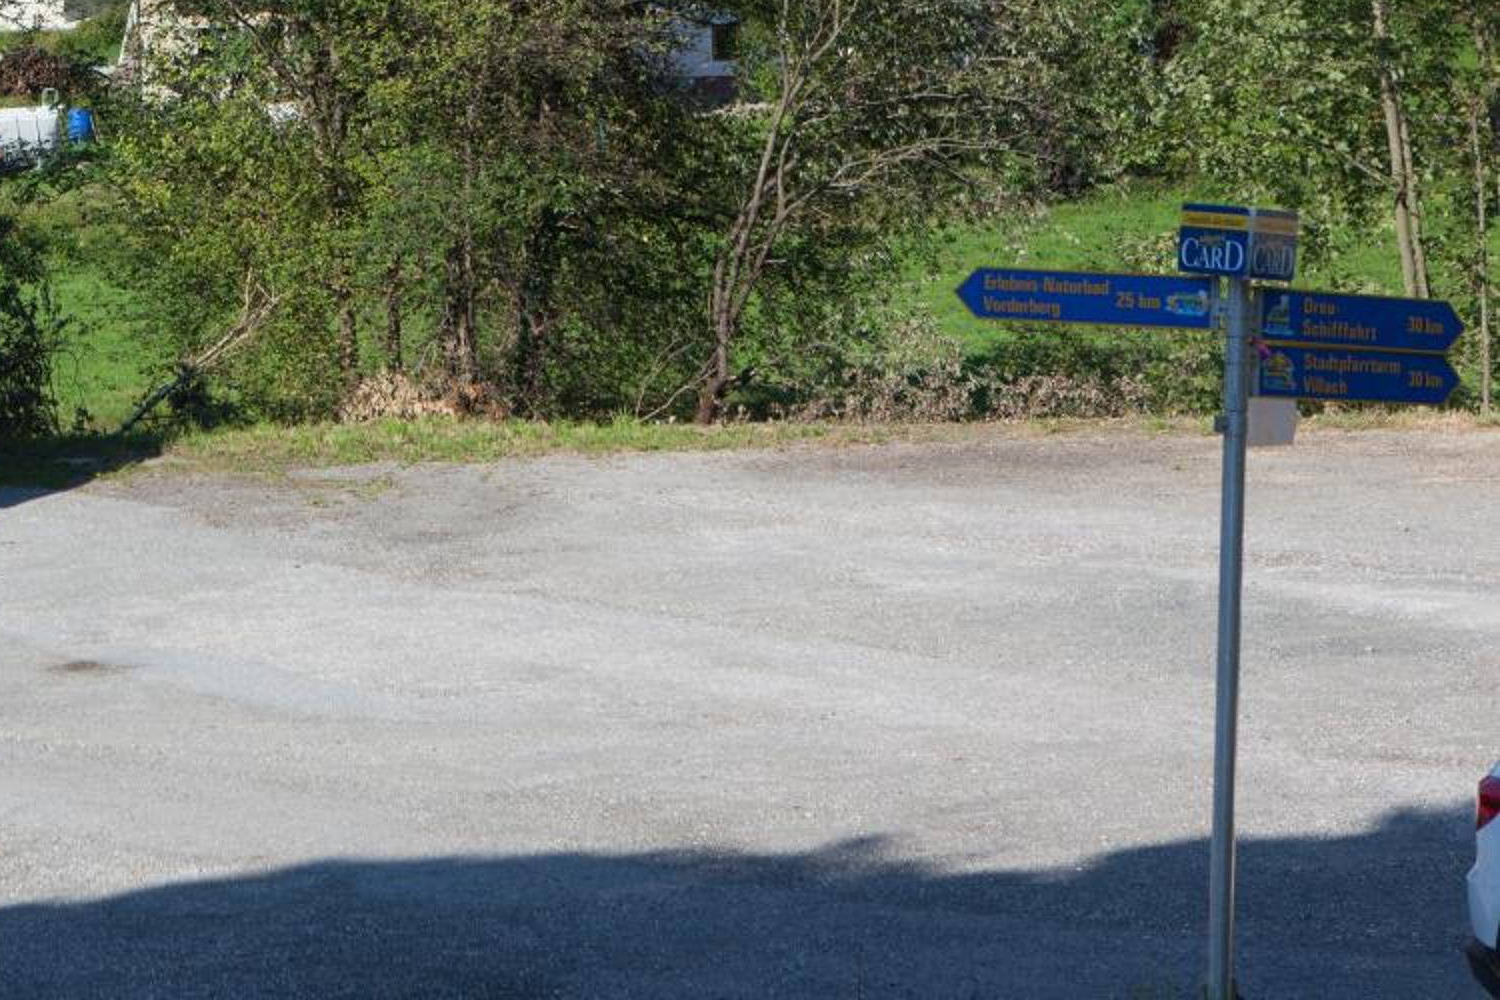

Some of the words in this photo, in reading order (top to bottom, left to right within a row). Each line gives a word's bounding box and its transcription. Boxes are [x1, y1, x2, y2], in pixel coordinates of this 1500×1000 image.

[1181, 236, 1244, 271] CARD
[984, 295, 1061, 319] Vorderberg
[1116, 292, 1135, 309] 25
[1138, 292, 1162, 309] km
[1409, 316, 1424, 333] 30
[1425, 317, 1445, 336] km
[1304, 374, 1349, 395] Villach
[1409, 370, 1424, 388] 30
[1425, 370, 1444, 389] km
